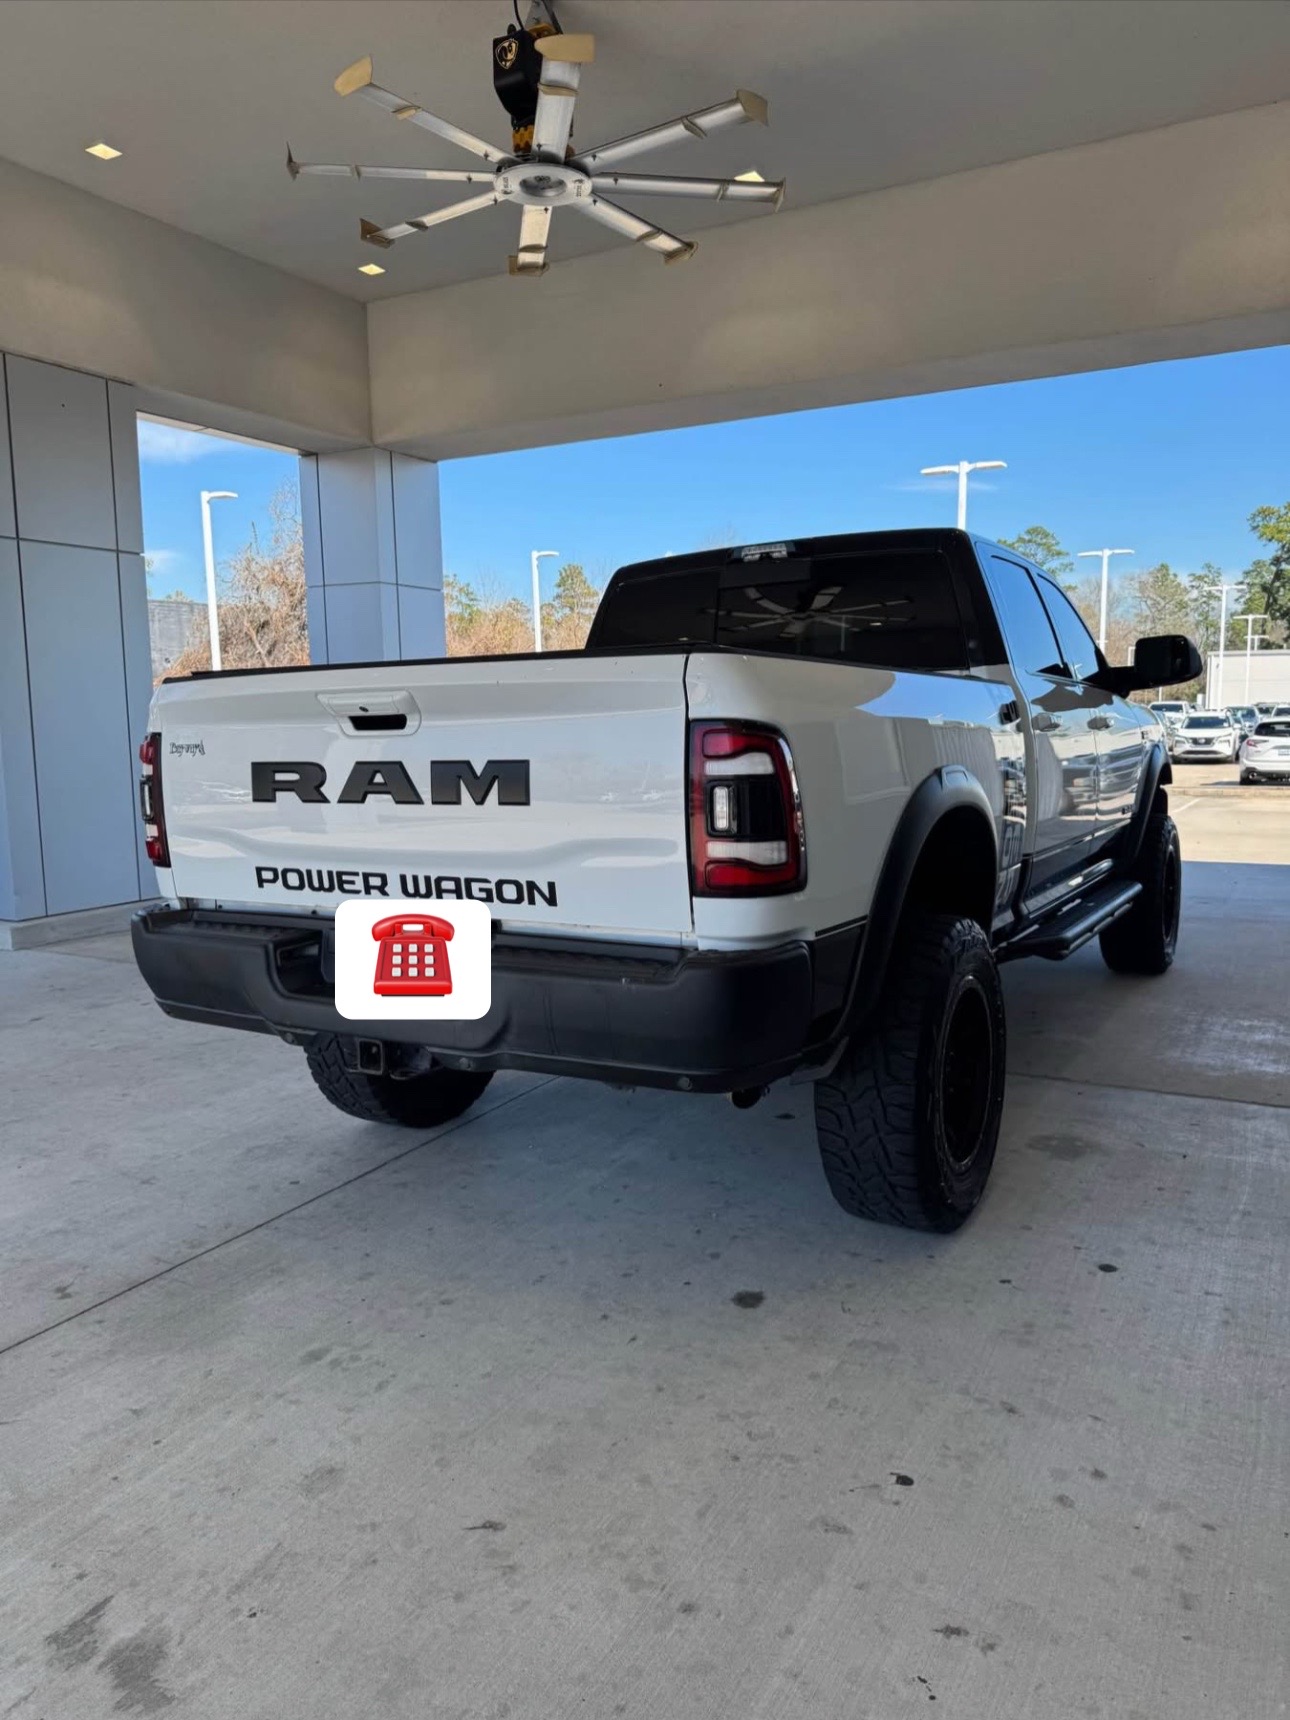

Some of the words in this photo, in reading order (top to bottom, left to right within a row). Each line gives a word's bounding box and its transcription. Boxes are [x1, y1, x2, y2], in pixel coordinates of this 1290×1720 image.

[251, 760, 530, 806] RAM
[255, 866, 389, 896] POWER
[399, 873, 558, 907] WAGON
